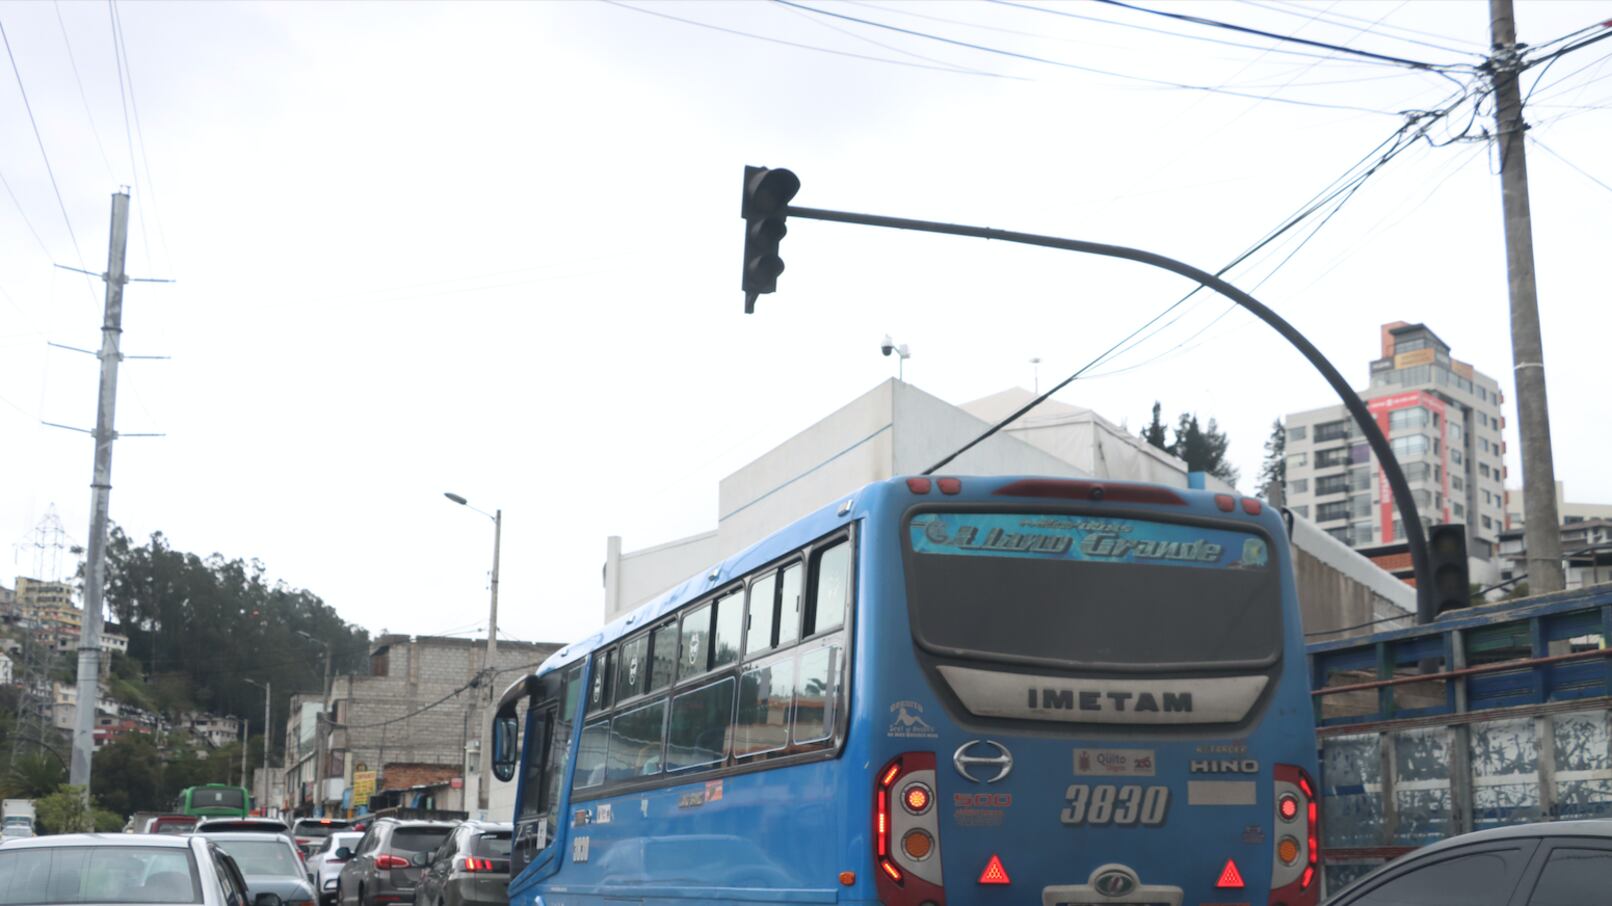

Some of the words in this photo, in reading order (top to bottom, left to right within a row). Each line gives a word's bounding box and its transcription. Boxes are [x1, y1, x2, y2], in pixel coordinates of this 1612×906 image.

[1080, 532, 1224, 562] Grande
[1028, 688, 1193, 713] IMETAM
[1190, 759, 1260, 773] HINO
[1060, 784, 1171, 826] 3830
